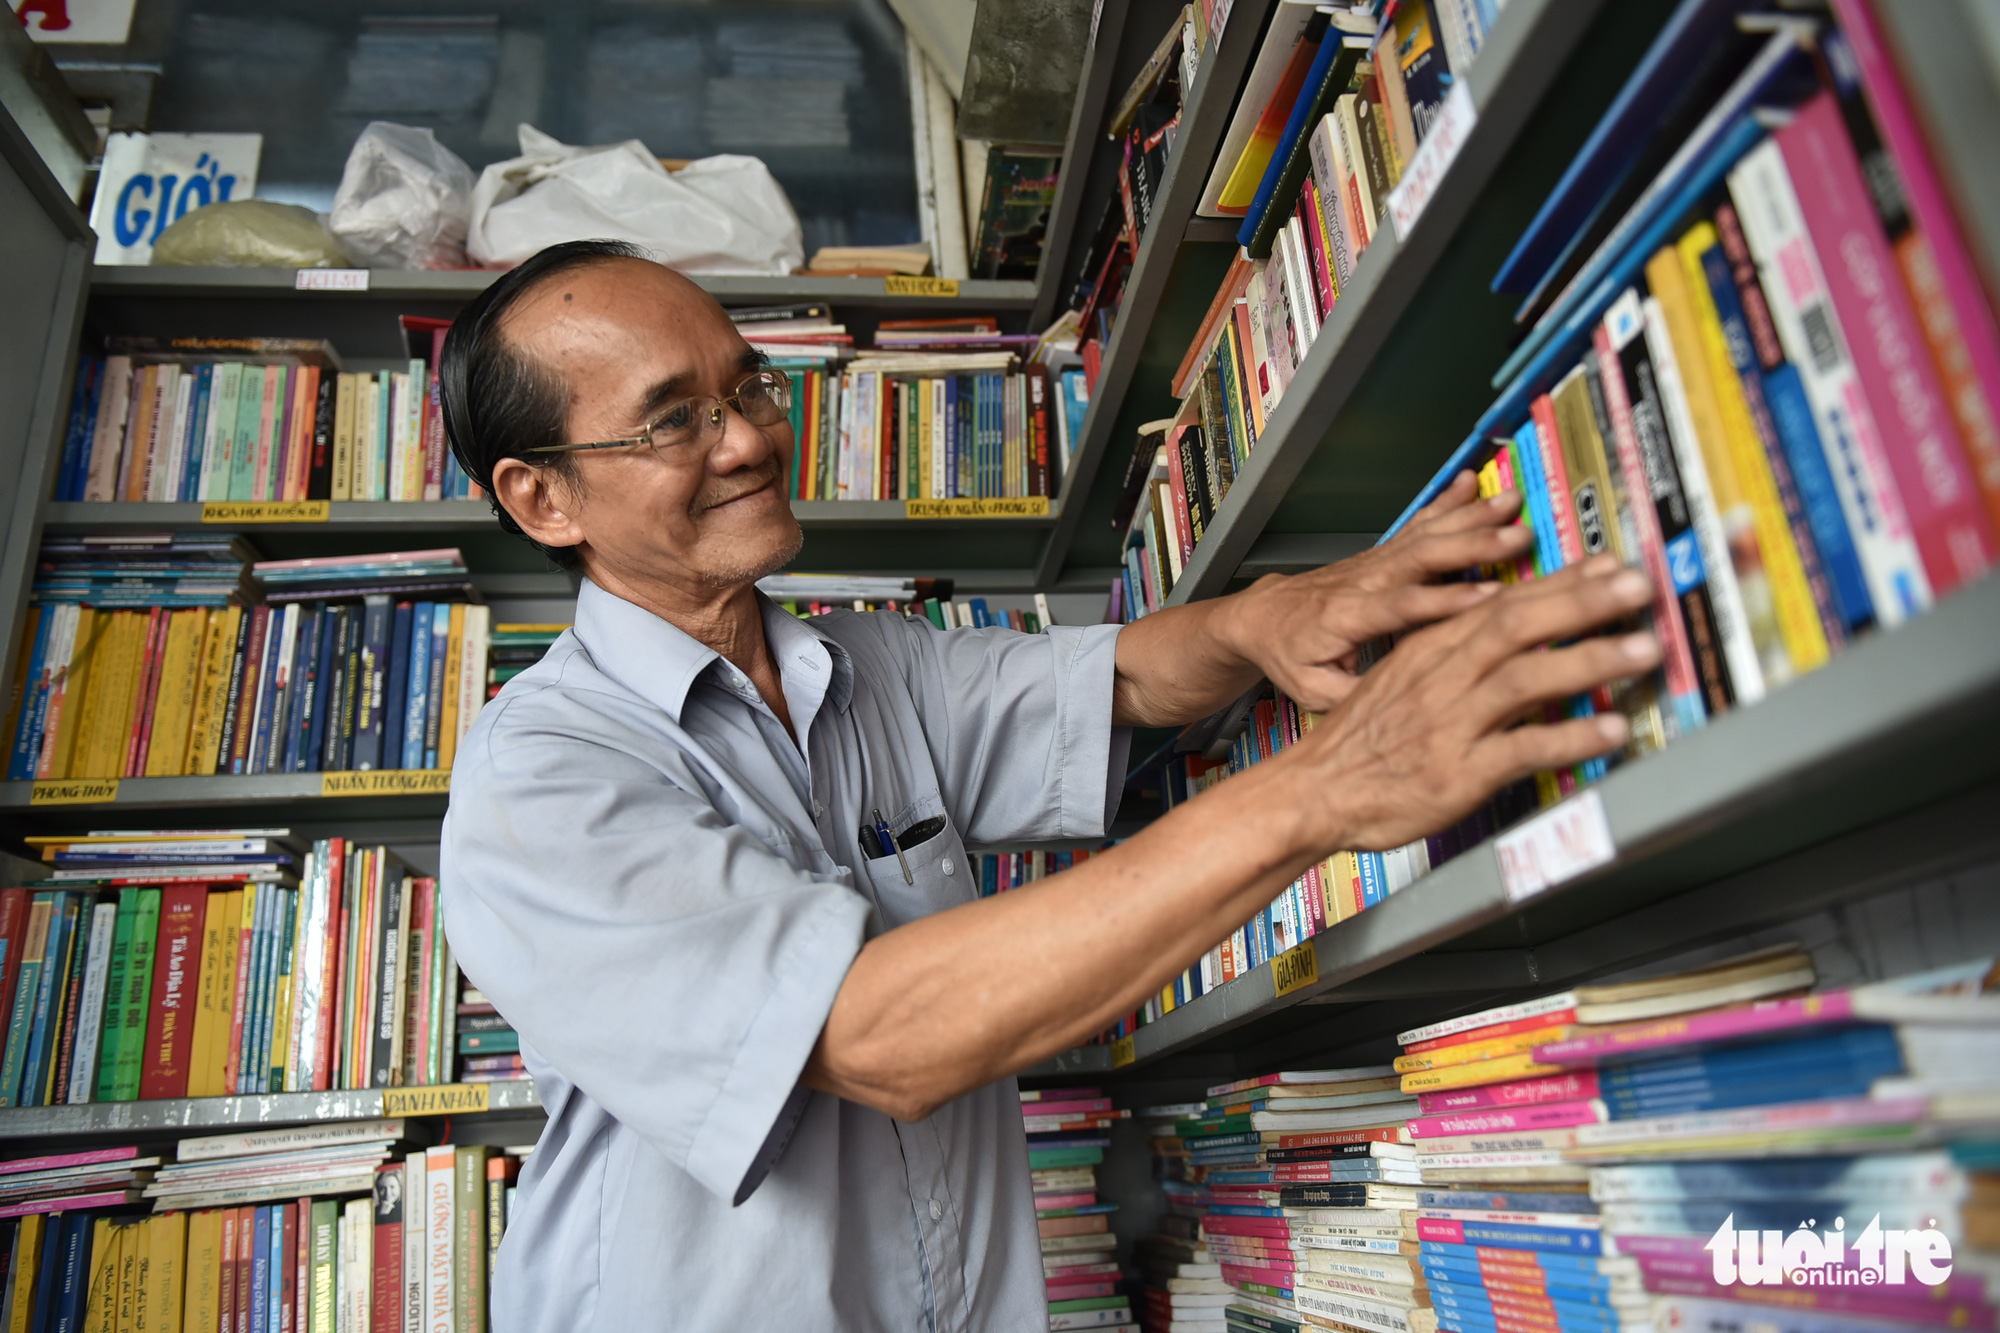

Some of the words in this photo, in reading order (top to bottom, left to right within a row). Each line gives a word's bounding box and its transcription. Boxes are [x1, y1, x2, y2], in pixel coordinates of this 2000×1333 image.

[32, 785, 79, 799] PHONG
[82, 780, 115, 797] THỦY
[1305, 904, 1313, 931] ROCK
[383, 964, 396, 993] MINH
[388, 1091, 434, 1114] DANH
[437, 1085, 486, 1111] NHÂN
[1329, 1136, 1336, 1144] BÀ
[1342, 1134, 1354, 1142] KHÁC
[432, 1182, 450, 1238] GƯƠNG
[389, 1226, 400, 1284] HILLARY
[430, 1244, 452, 1280] MẶT
[104, 1264, 114, 1292] Khám
[138, 1257, 150, 1287] Khám
[252, 1258, 266, 1288] Những
[102, 1294, 113, 1308] phá
[135, 1288, 148, 1304] phá
[254, 1290, 265, 1312] chân
[375, 1266, 386, 1316] LIVING
[432, 1283, 454, 1318] NHÀ
[254, 1314, 264, 1328] trời
